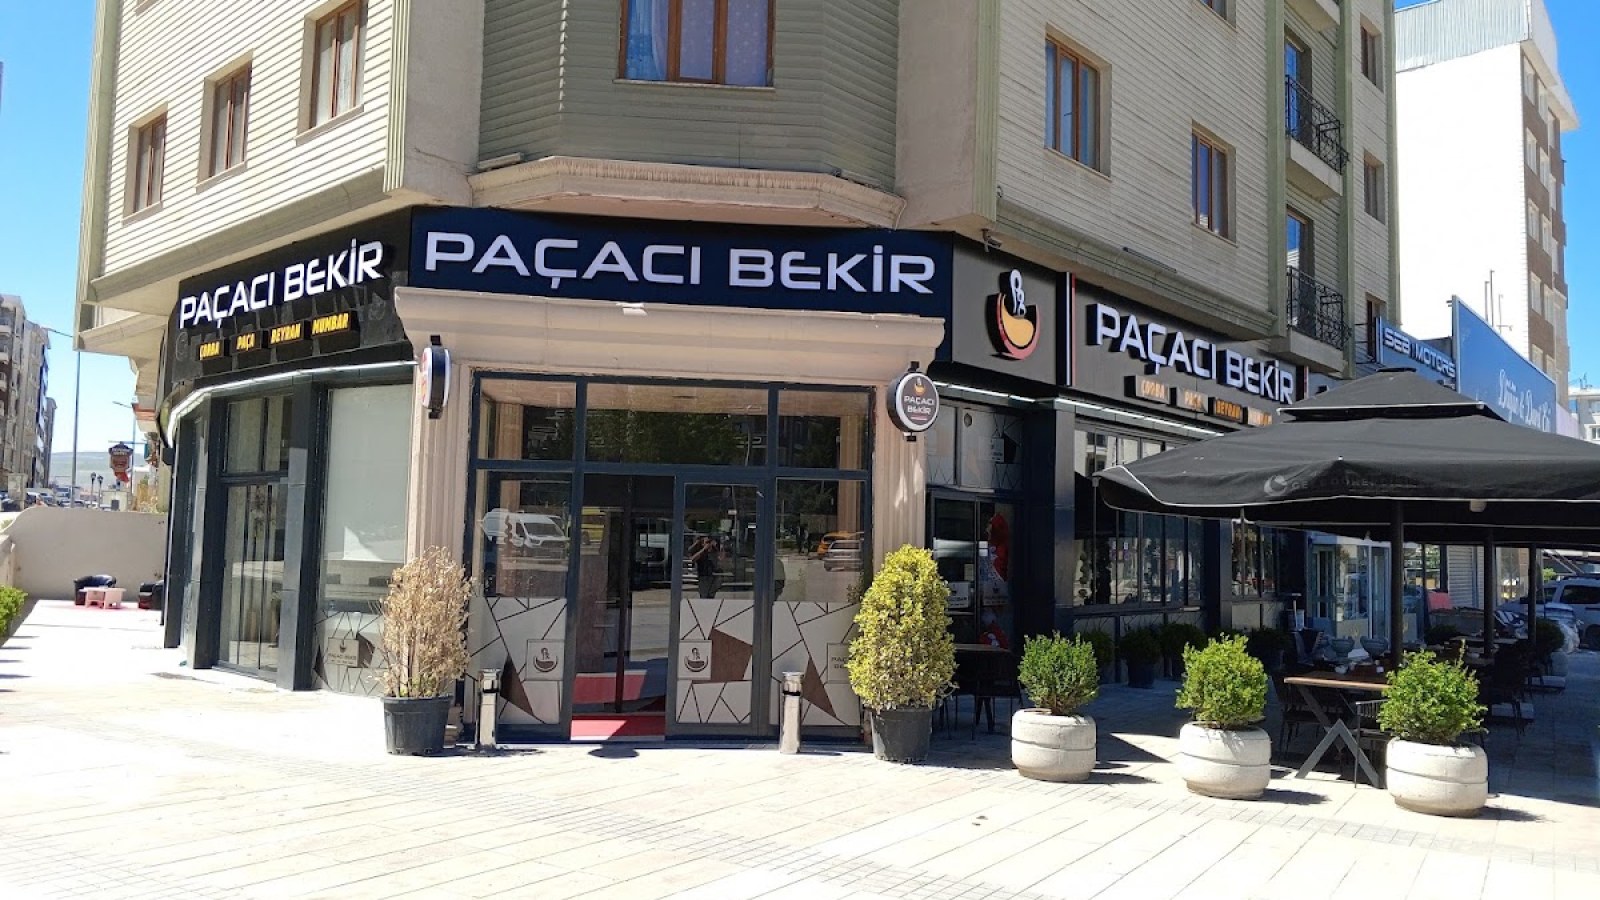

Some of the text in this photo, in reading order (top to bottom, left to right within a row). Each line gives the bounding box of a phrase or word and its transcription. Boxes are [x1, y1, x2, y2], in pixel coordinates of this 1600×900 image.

[425, 231, 935, 294] PAÇACI BEKİR
[180, 238, 384, 329] PAÇACI BEKİR
[237, 333, 255, 350] PAÇA
[271, 324, 301, 344] BEYRAN
[312, 313, 349, 335] MUMBAR
[1096, 303, 1294, 404] PAÇACI BEKİR
[1415, 343, 1455, 378] MOTORS
[903, 395, 934, 405] PAÇACI
[907, 405, 931, 414] BEKİR
